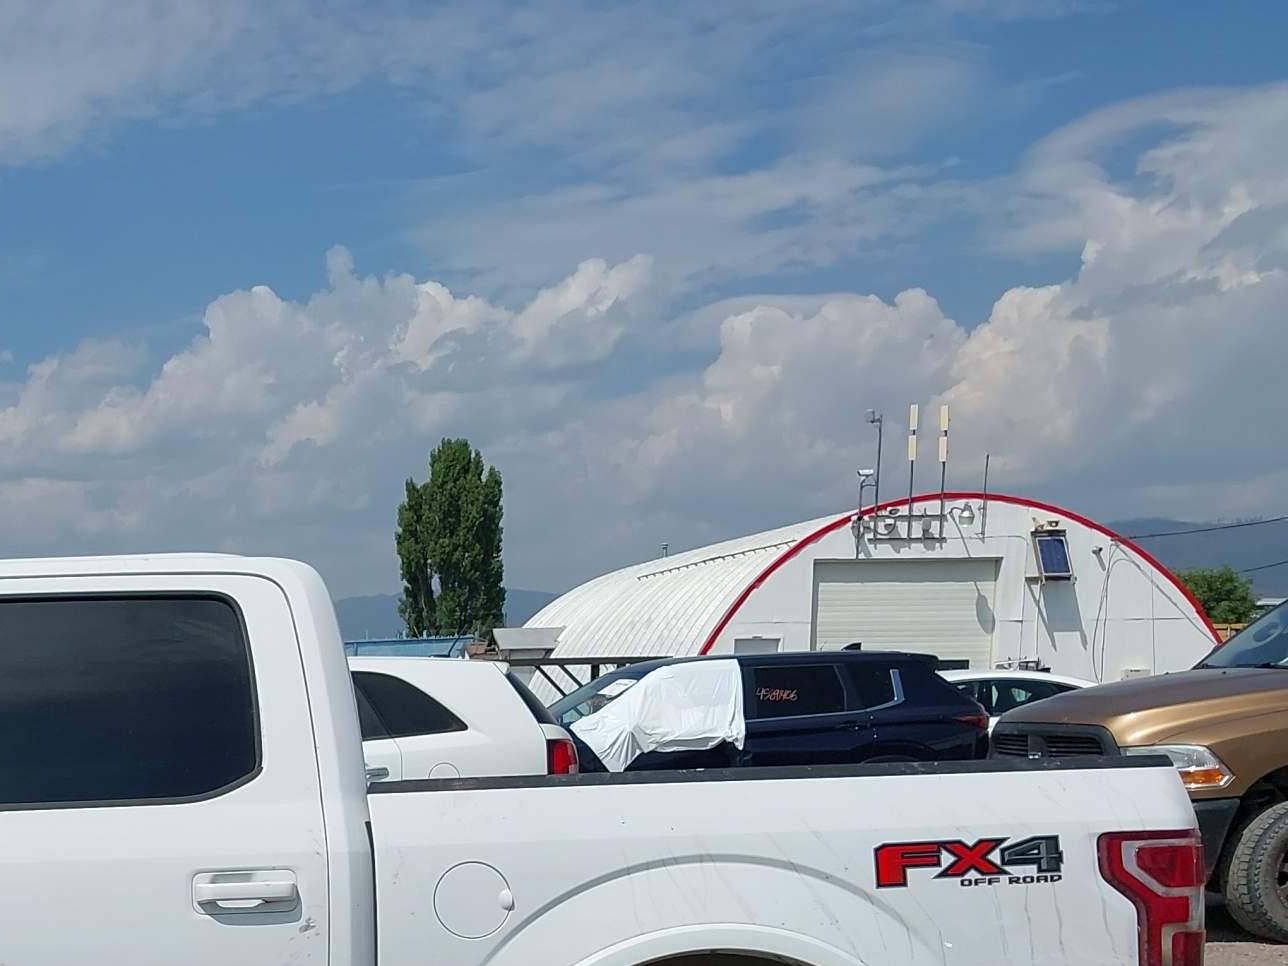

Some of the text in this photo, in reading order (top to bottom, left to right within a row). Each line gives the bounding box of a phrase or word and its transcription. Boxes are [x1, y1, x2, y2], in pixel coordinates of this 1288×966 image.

[874, 834, 1064, 889] FX4
[960, 874, 1062, 888] OFF ROAD
